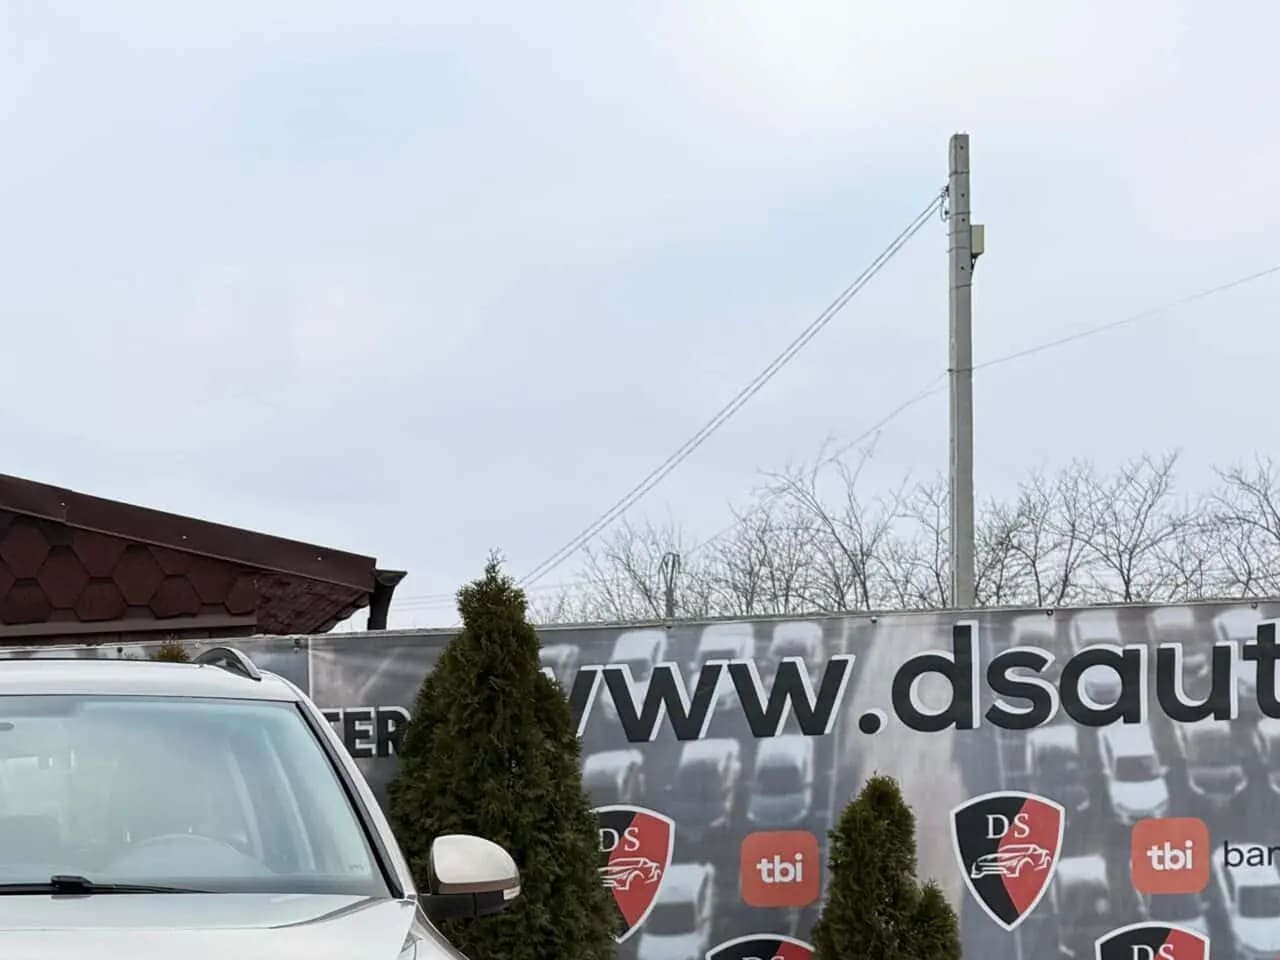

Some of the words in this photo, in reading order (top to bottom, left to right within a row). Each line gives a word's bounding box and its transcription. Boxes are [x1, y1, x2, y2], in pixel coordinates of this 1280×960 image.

[542, 619, 1280, 743] ww.dsaut
[599, 827, 640, 852] DS
[985, 814, 1030, 839] DS
[756, 853, 803, 884] tbi
[1147, 841, 1193, 871] tbi
